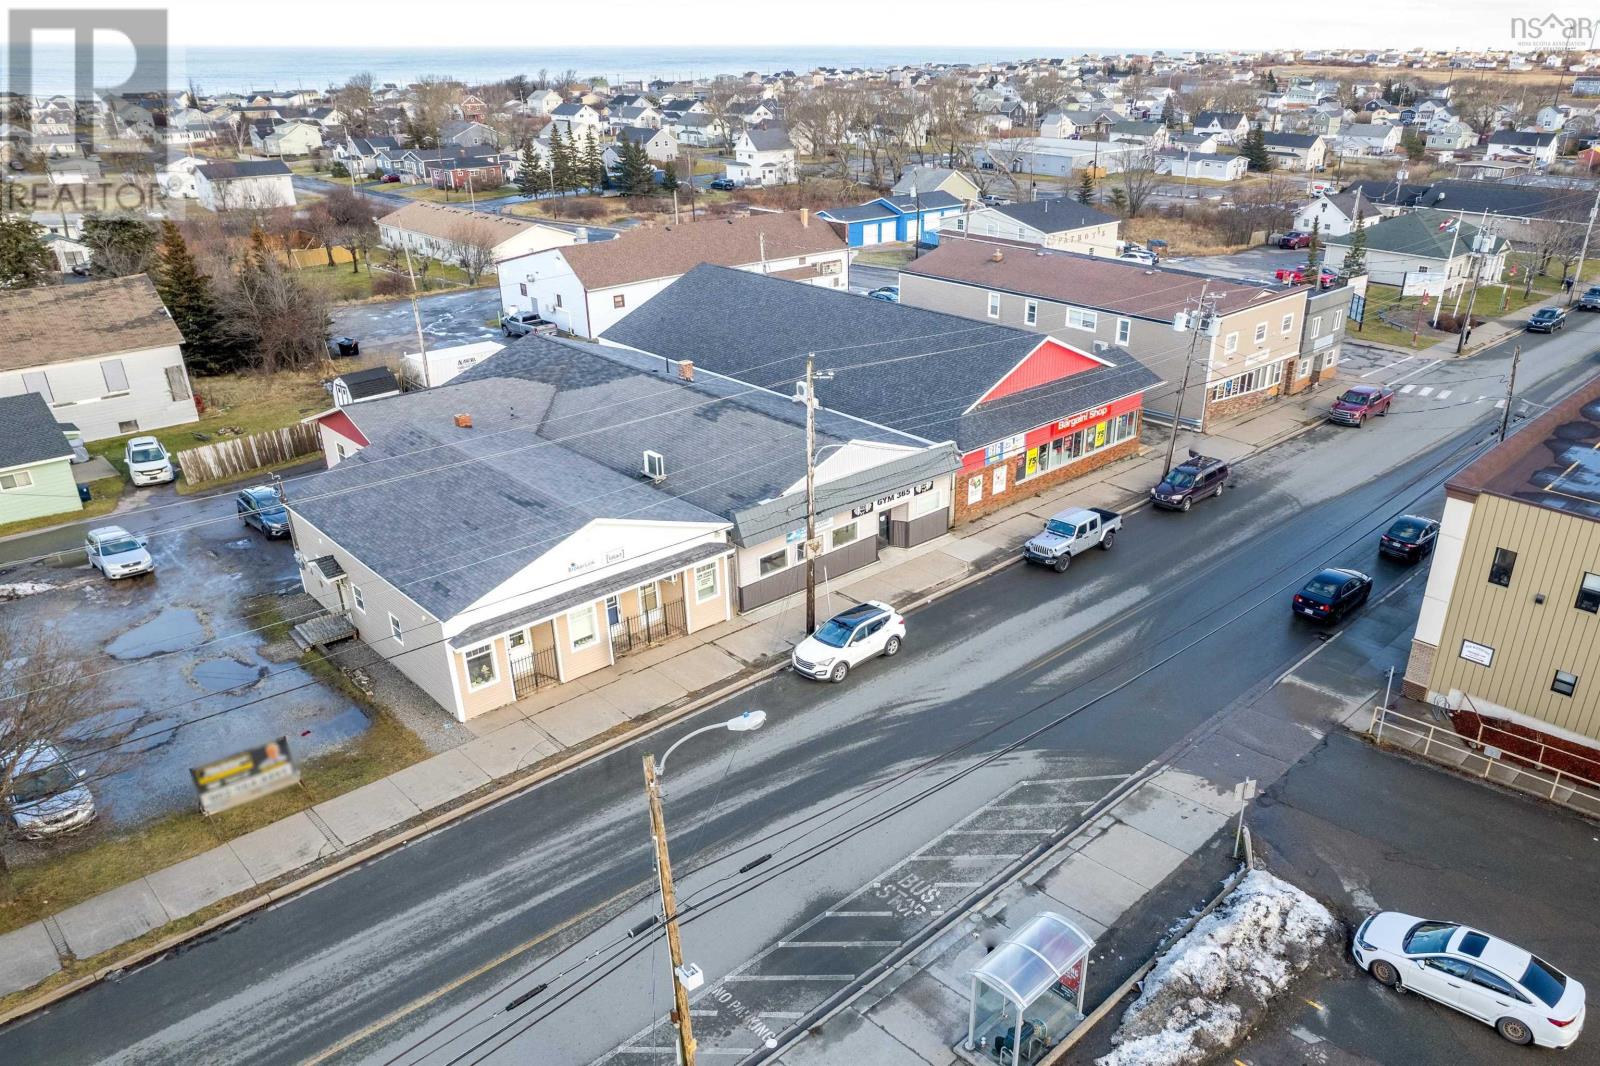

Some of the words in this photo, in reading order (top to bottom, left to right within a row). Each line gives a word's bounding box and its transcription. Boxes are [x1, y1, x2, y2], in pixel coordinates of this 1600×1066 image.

[1089, 406, 1108, 418] Shop
[1028, 456, 1037, 466] 75
[877, 495, 894, 505] GYM
[897, 490, 910, 498] 365
[898, 873, 940, 902] BUS
[711, 986, 733, 1003] NO
